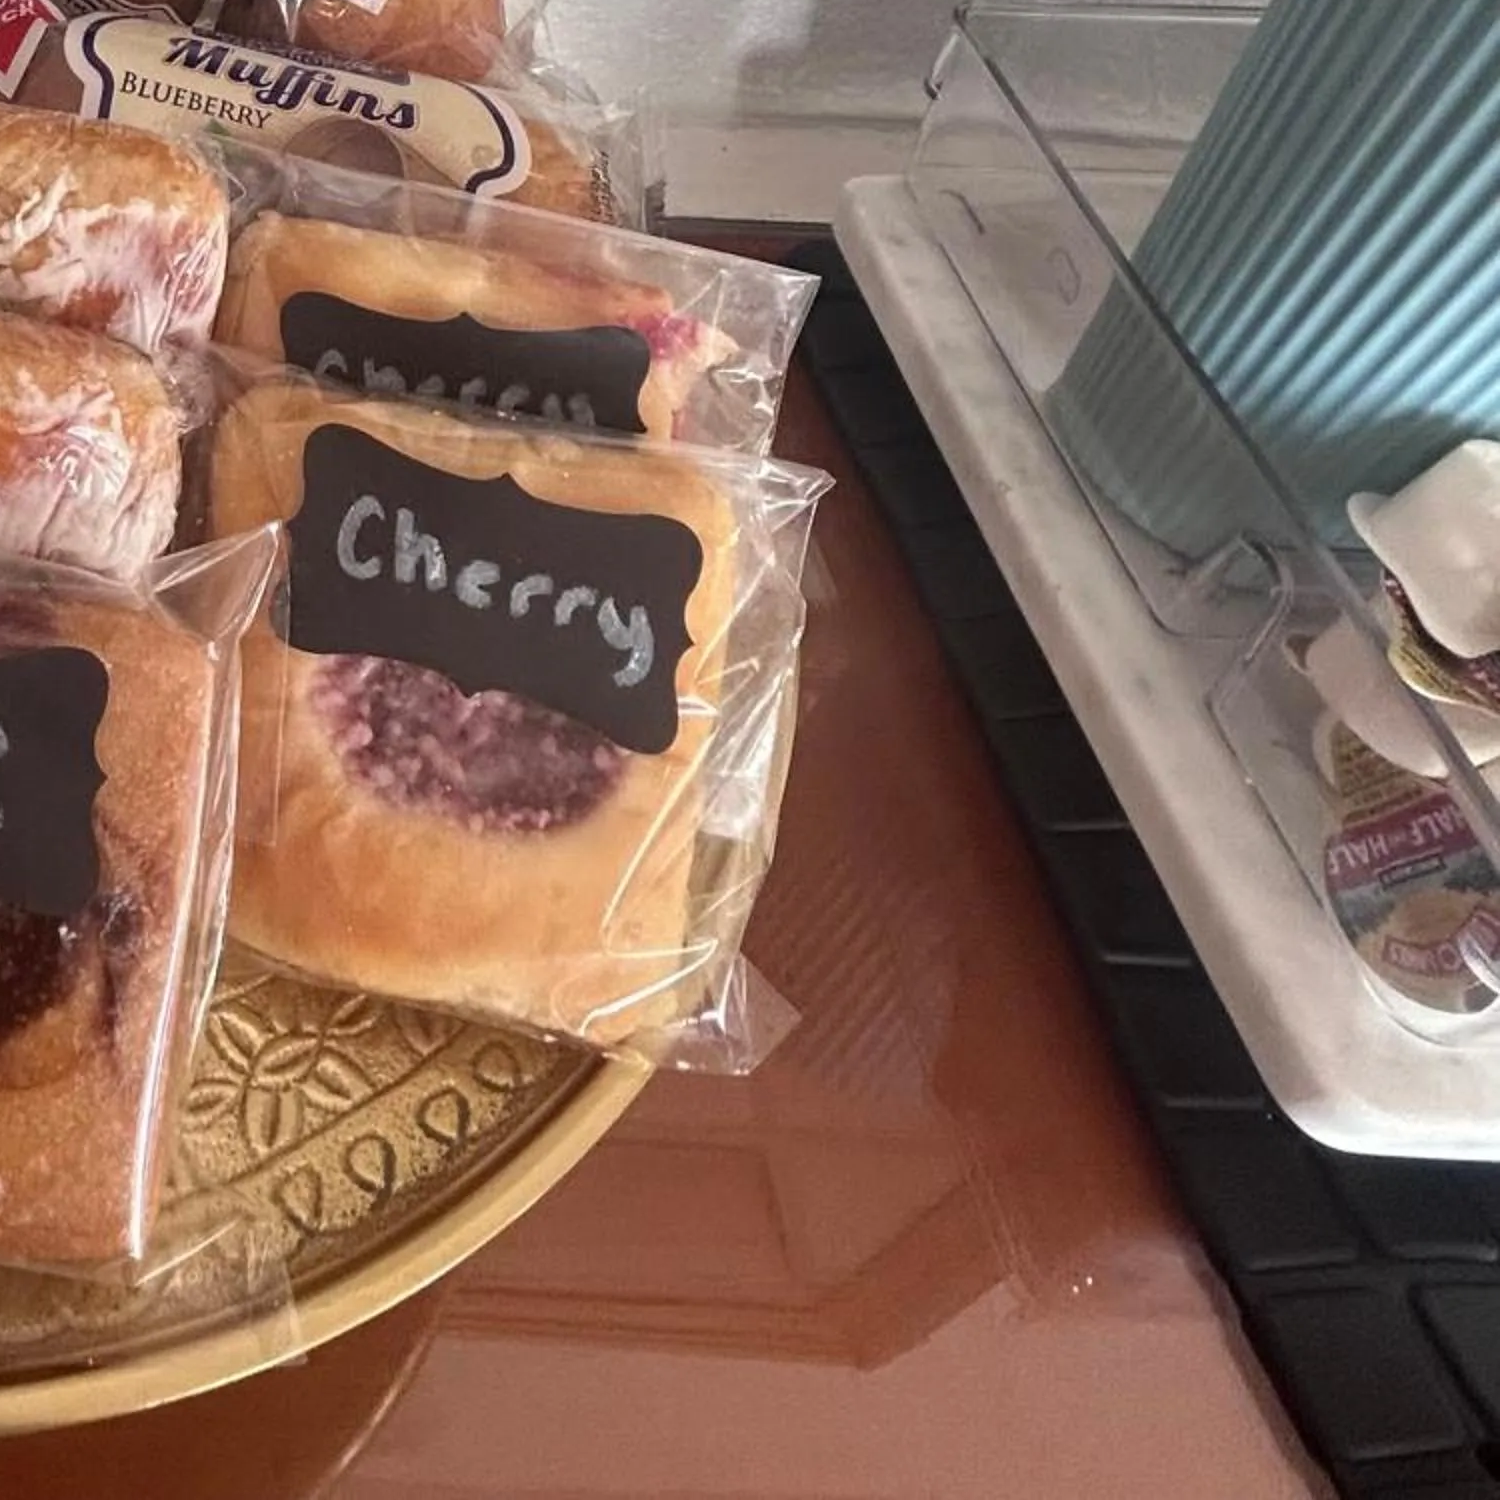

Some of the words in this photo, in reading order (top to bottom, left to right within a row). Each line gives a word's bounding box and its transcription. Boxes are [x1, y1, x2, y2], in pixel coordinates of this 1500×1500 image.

[119, 70, 274, 131] BLUEBERRY
[163, 36, 417, 130] Muffins
[336, 494, 656, 688] Cherry
